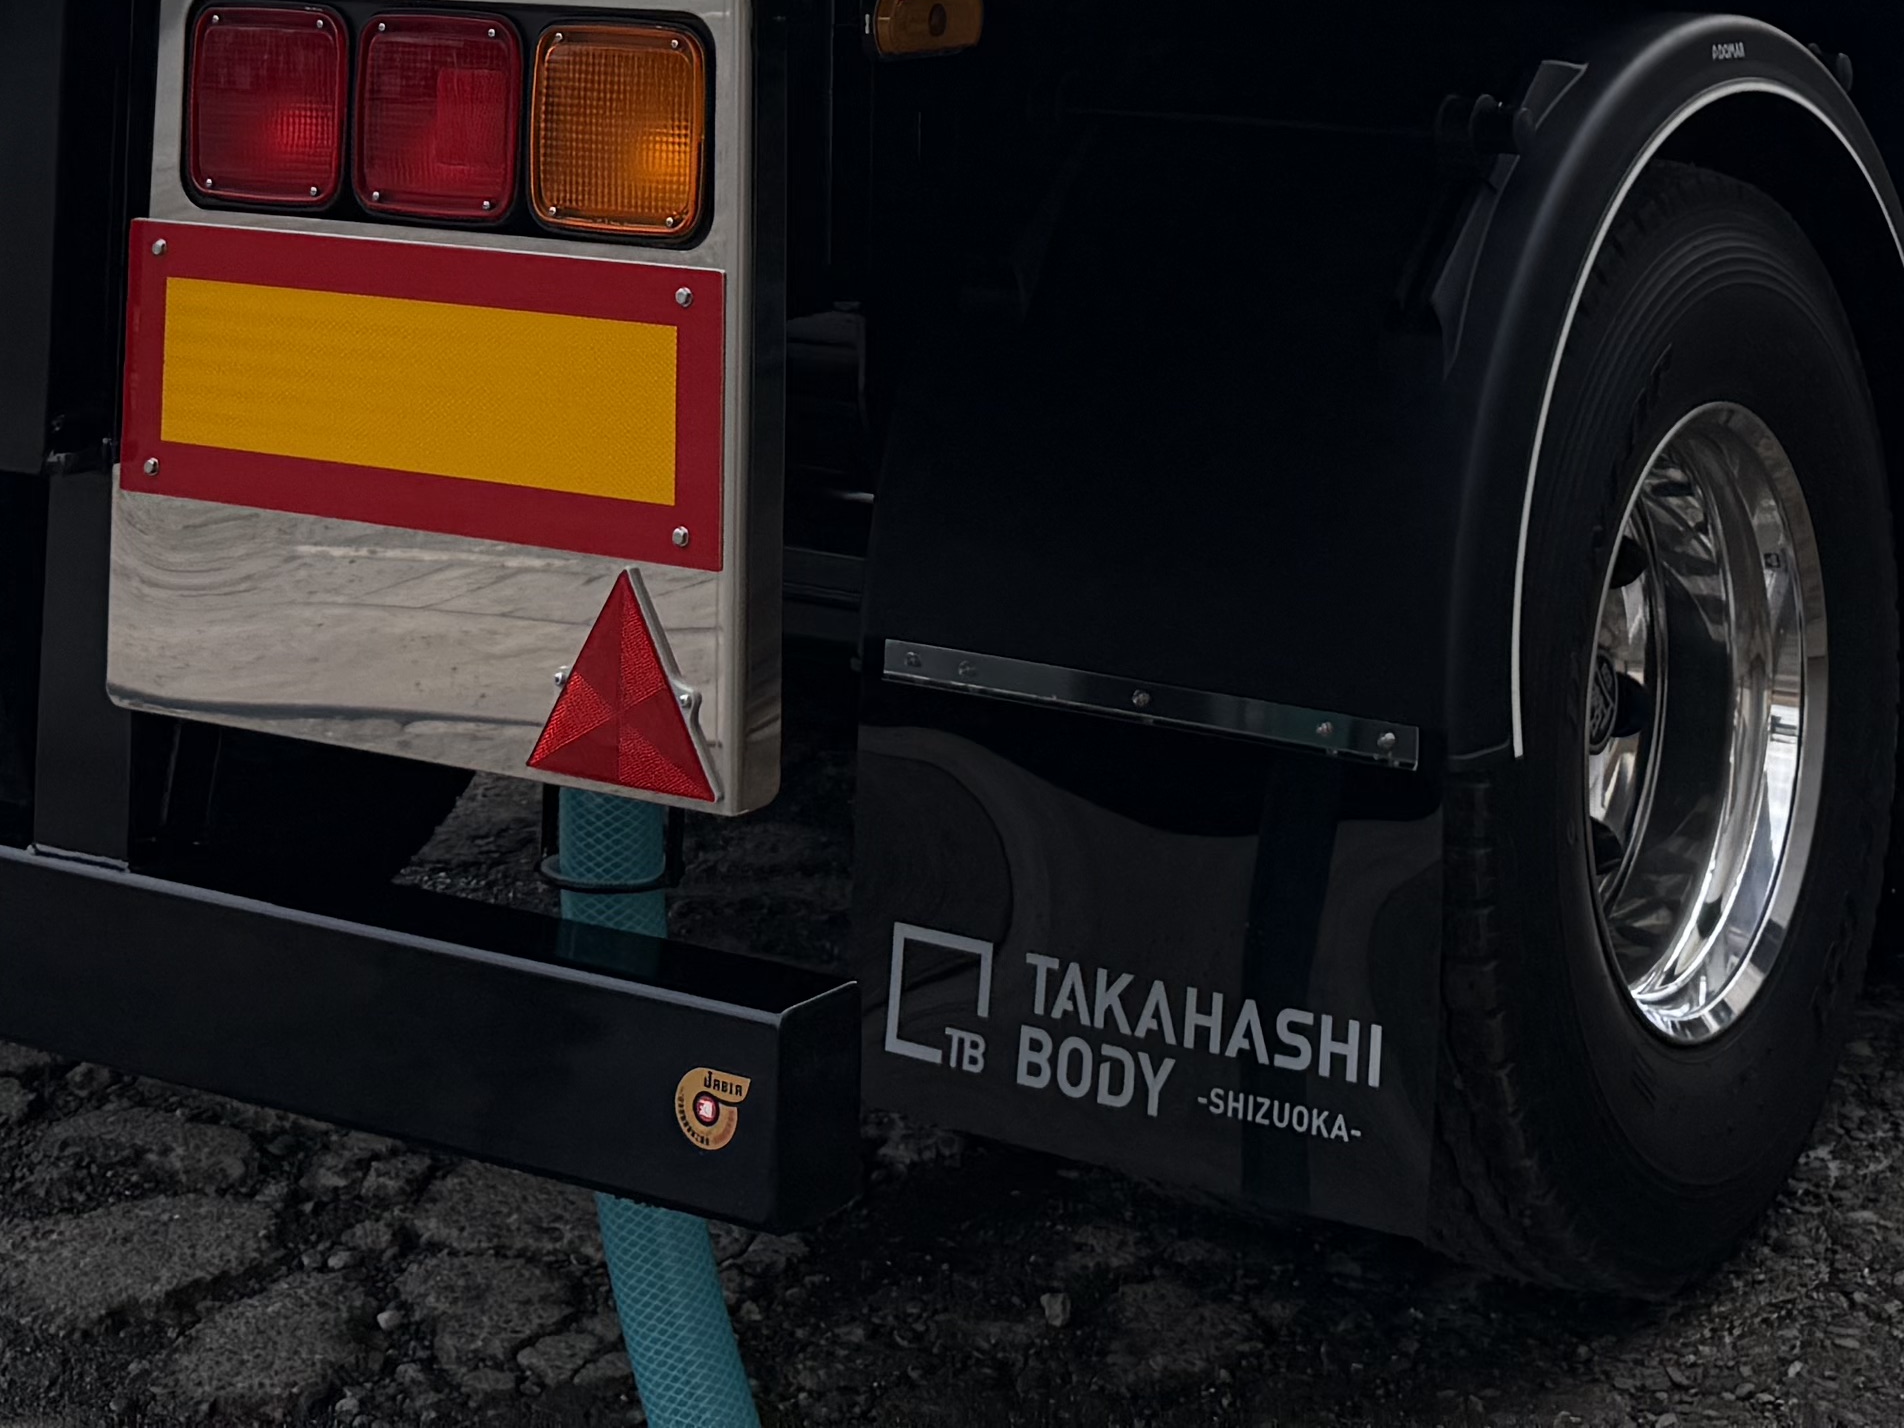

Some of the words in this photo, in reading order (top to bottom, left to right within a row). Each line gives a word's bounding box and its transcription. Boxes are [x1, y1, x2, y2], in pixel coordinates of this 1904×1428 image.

[944, 1026, 986, 1074] TB
[1025, 952, 1383, 1088] TAKAHASHI
[1016, 1024, 1176, 1117] BODY
[1197, 1087, 1362, 1143] -SHIZUOKA-
